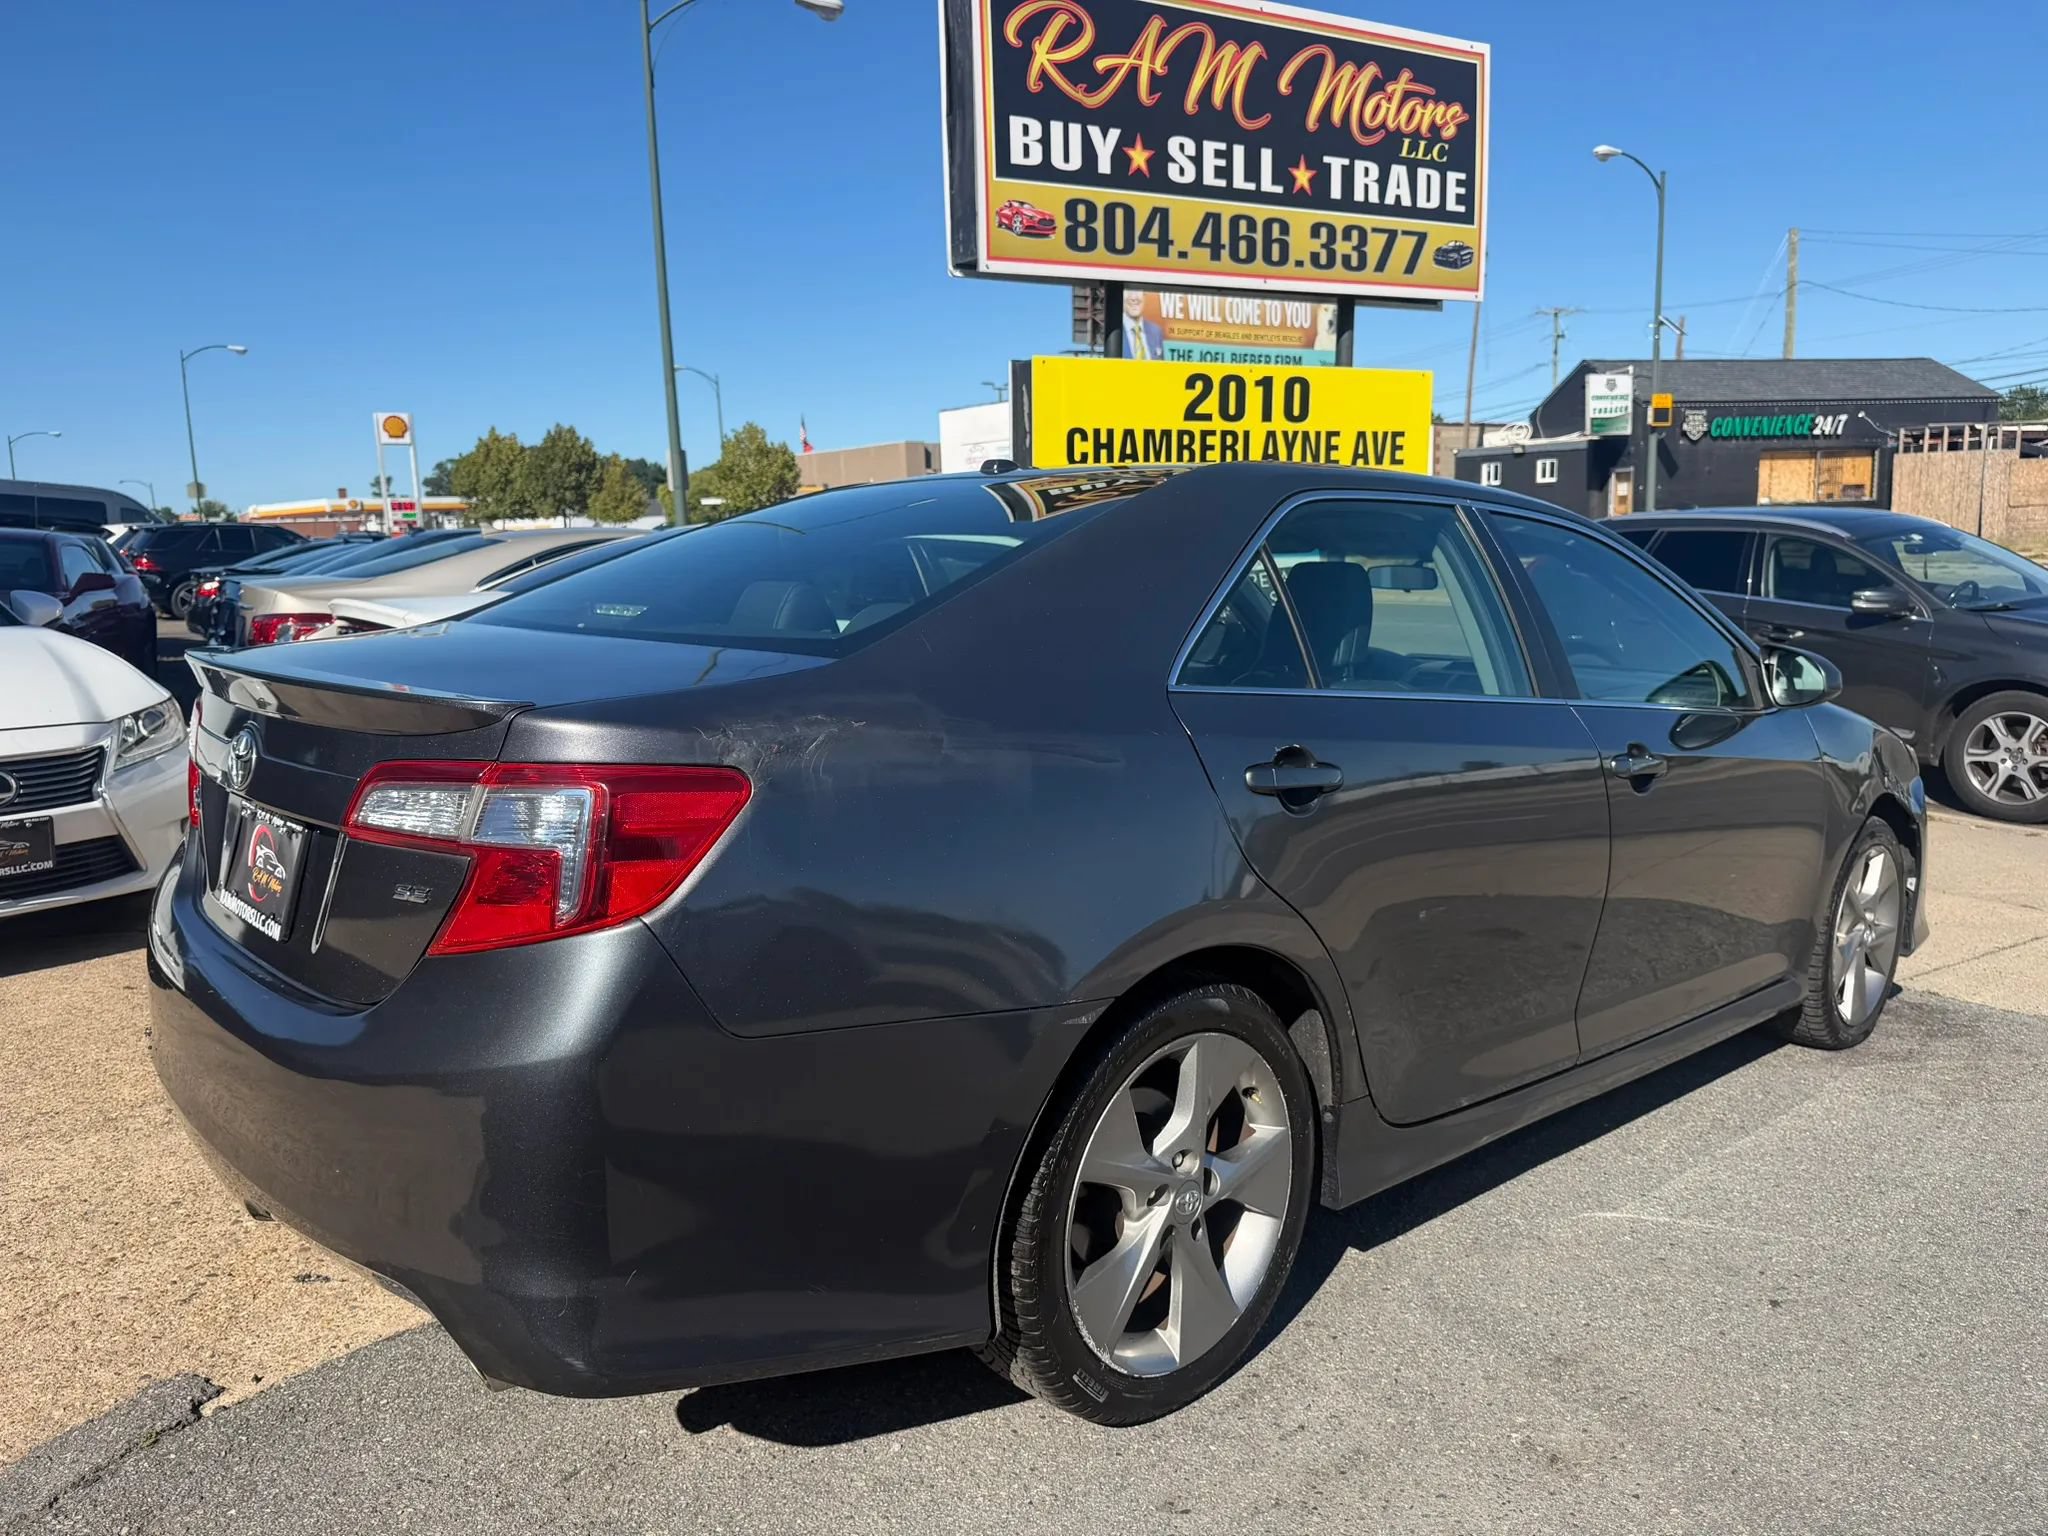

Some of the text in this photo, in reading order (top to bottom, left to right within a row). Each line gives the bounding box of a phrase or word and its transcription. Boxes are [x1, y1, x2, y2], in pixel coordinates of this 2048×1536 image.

[1003, 0, 1470, 146] RAM Motors
[1009, 115, 1467, 213] BUY SELL TRADE
[1399, 137, 1449, 162] LLC
[1064, 198, 1428, 276] 804.466.3377
[1160, 292, 1312, 329] WE WILL COME TO YOU
[1169, 348, 1193, 362] THE
[1184, 373, 1310, 423] 2010
[1711, 413, 1848, 437] CONVENIENCE 24/7
[1066, 427, 1405, 466] CHAMBERLAYNE AVE
[393, 884, 432, 903] SE
